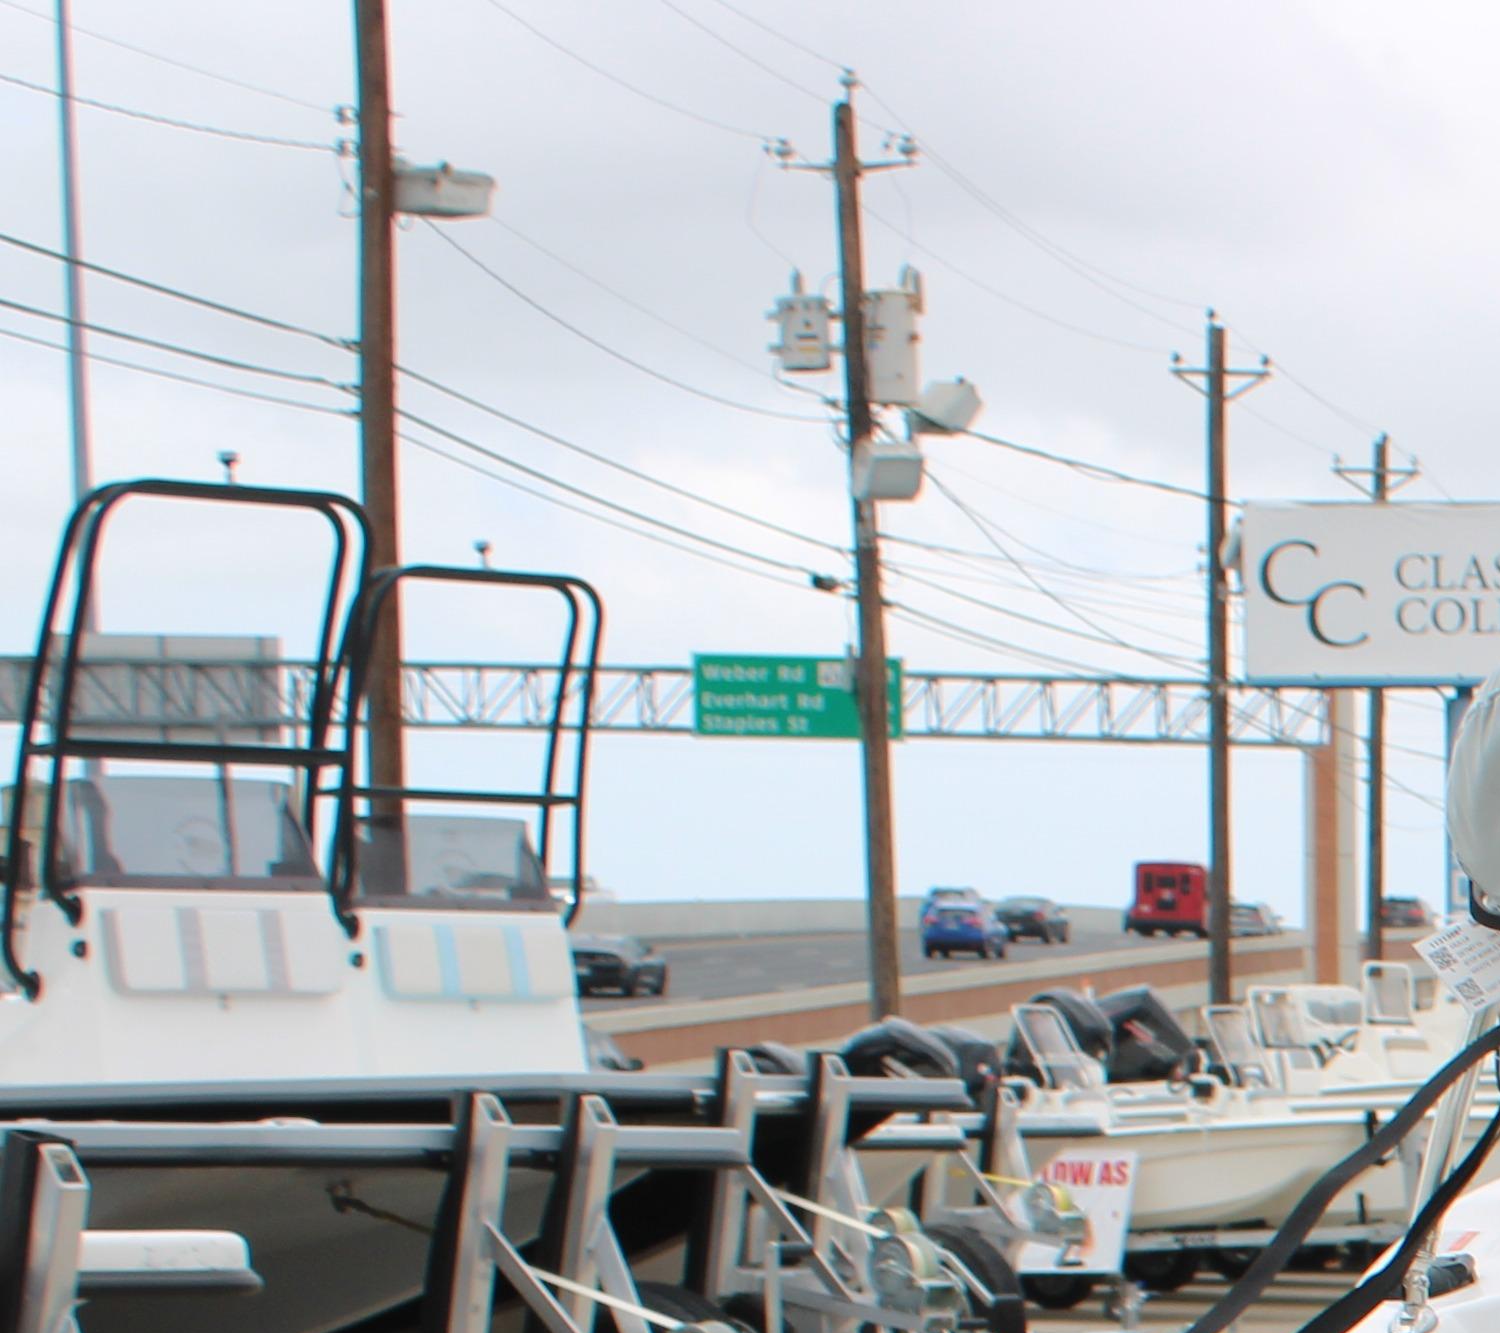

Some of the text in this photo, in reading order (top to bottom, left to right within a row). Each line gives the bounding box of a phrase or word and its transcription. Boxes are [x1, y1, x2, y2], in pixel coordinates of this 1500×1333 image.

[1260, 538, 1370, 649] CC
[701, 663, 769, 681] Weber
[777, 664, 806, 682] Rd
[701, 690, 825, 711] Everhart Rd
[701, 713, 809, 734] Staples St
[1099, 1161, 1129, 1185] AS
